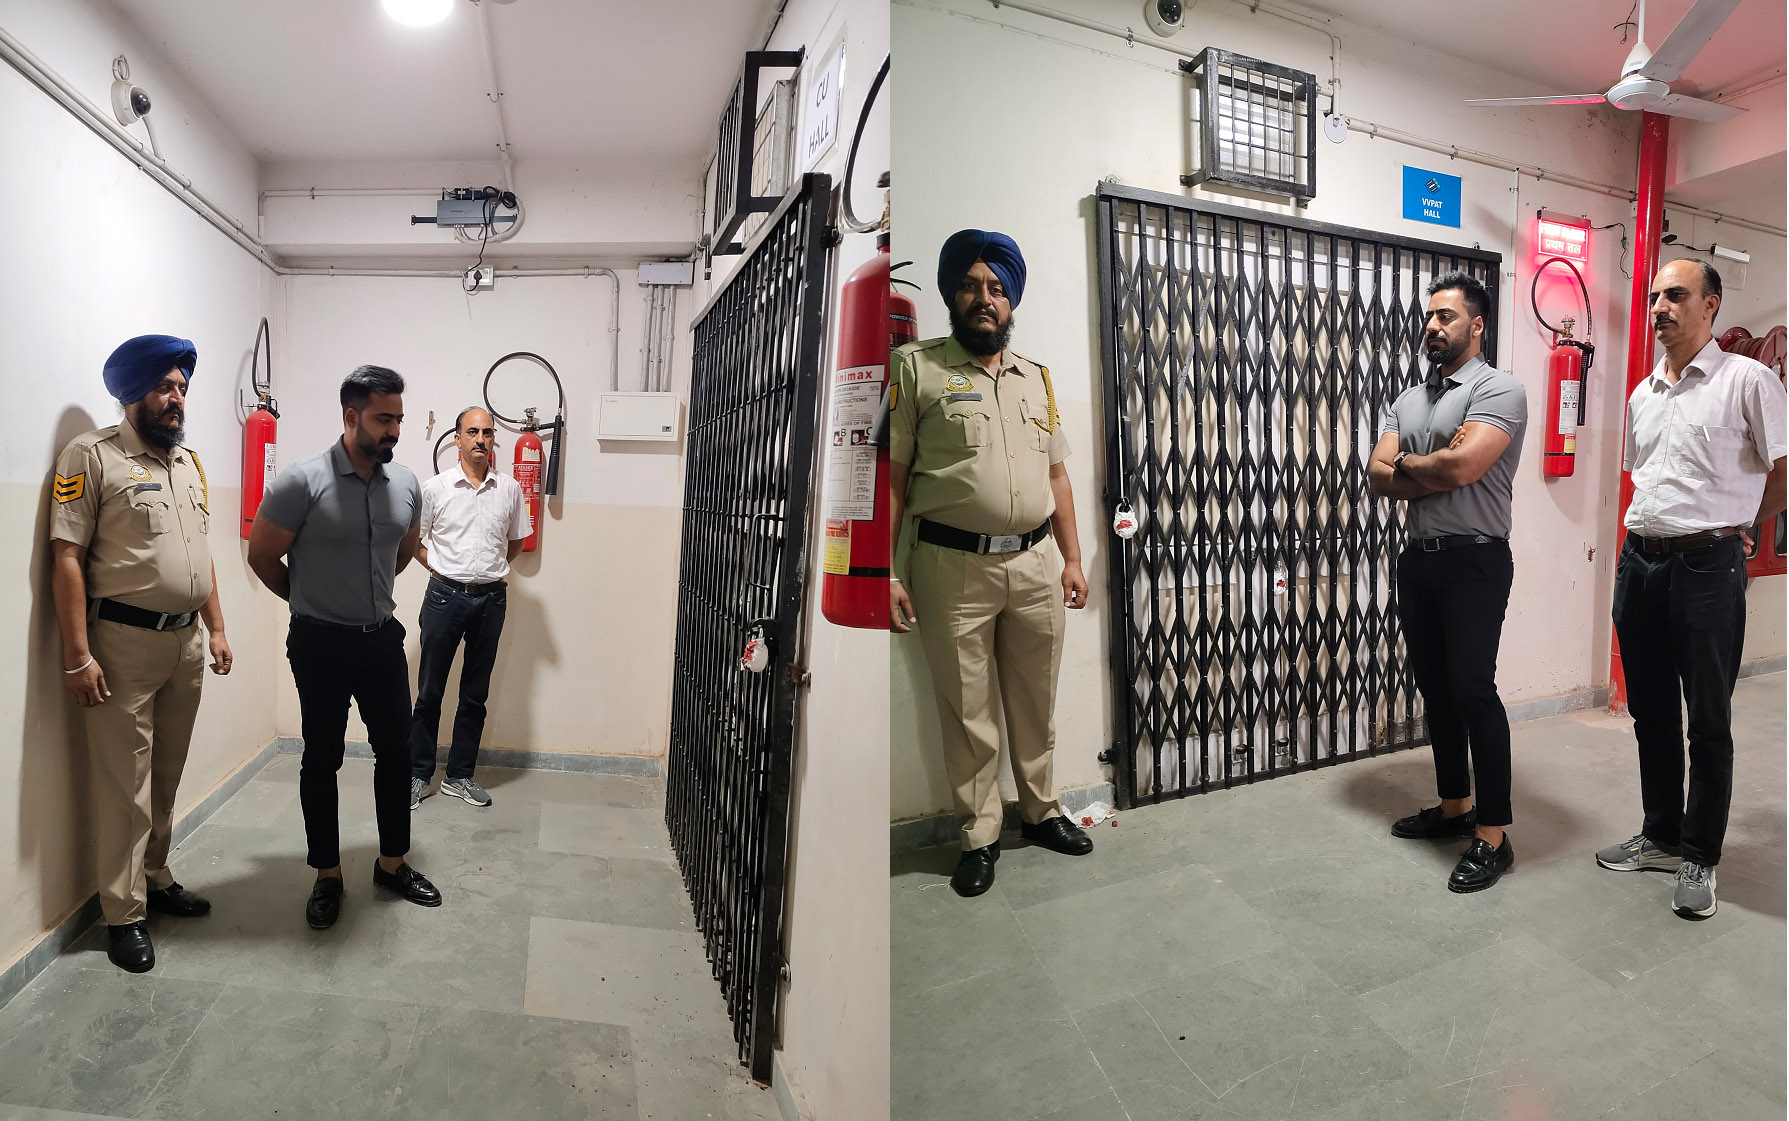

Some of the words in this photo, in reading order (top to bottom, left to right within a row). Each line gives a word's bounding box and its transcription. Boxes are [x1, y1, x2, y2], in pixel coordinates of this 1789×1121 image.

[816, 72, 829, 108] CU
[808, 114, 829, 158] HALL
[1421, 197, 1442, 208] VVPAT
[1423, 208, 1441, 219] HALL
[1544, 238, 1564, 251] प्रथम
[1566, 242, 1582, 255] तल
[841, 428, 847, 437] B
